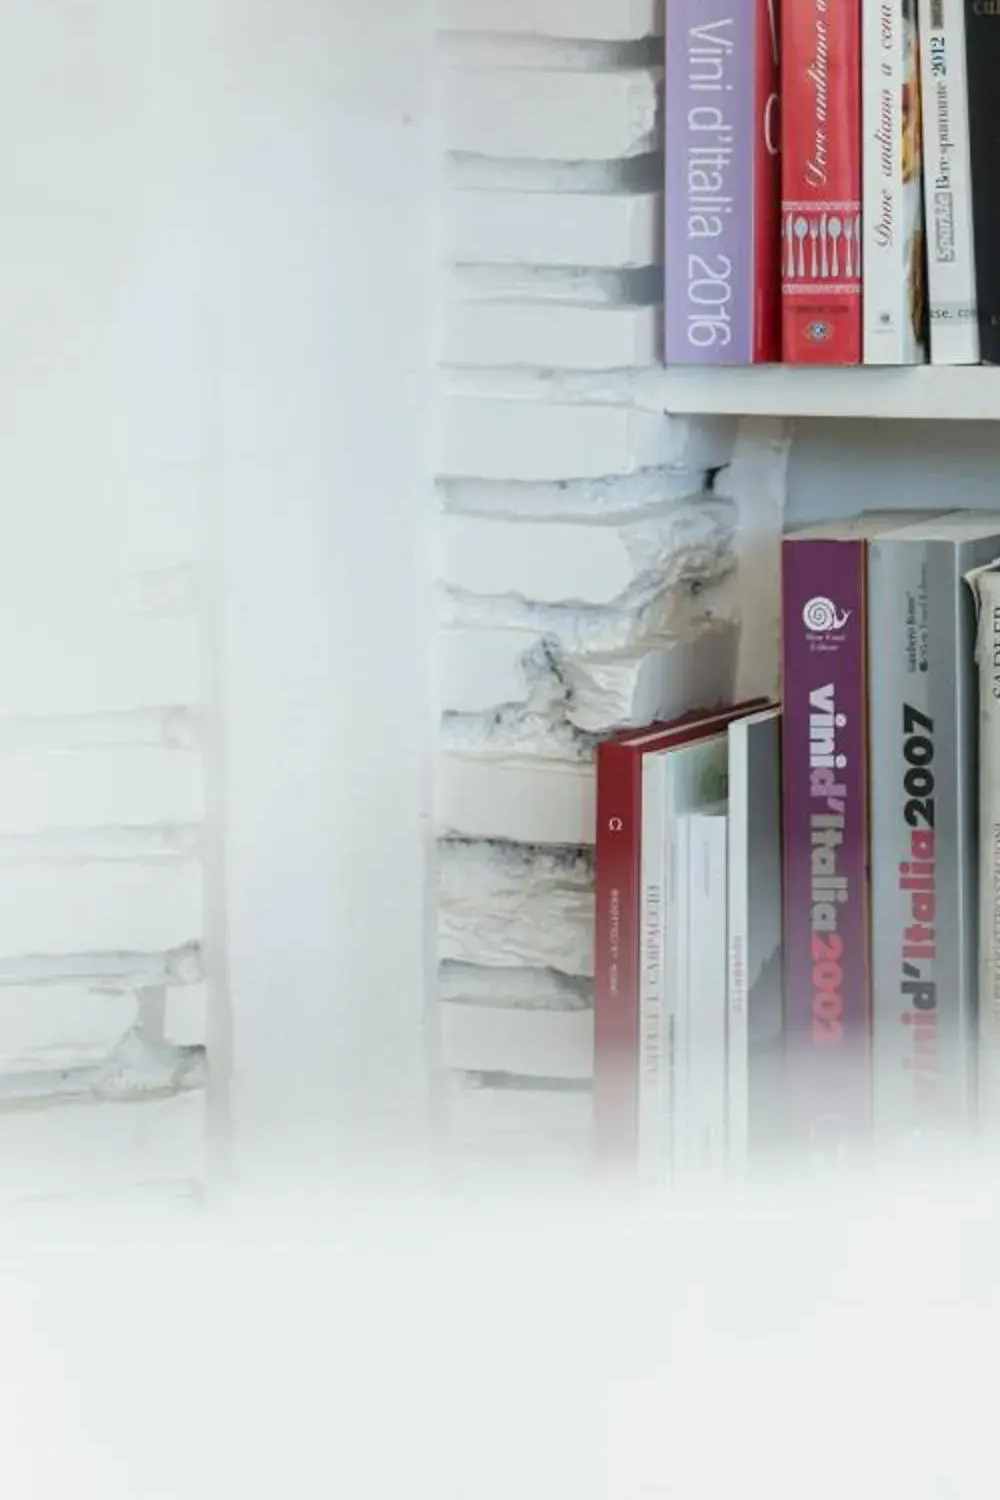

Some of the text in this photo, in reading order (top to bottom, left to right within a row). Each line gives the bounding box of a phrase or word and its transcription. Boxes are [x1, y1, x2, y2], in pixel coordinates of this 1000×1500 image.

[880, 4, 893, 50] cena
[806, 20, 828, 121] andiamo
[881, 64, 892, 77] a
[929, 36, 948, 77] 2012
[873, 89, 896, 177] andiamo
[687, 17, 734, 346] Vini d'Italia 2016
[936, 157, 951, 189] Bere
[874, 188, 893, 248] Dove
